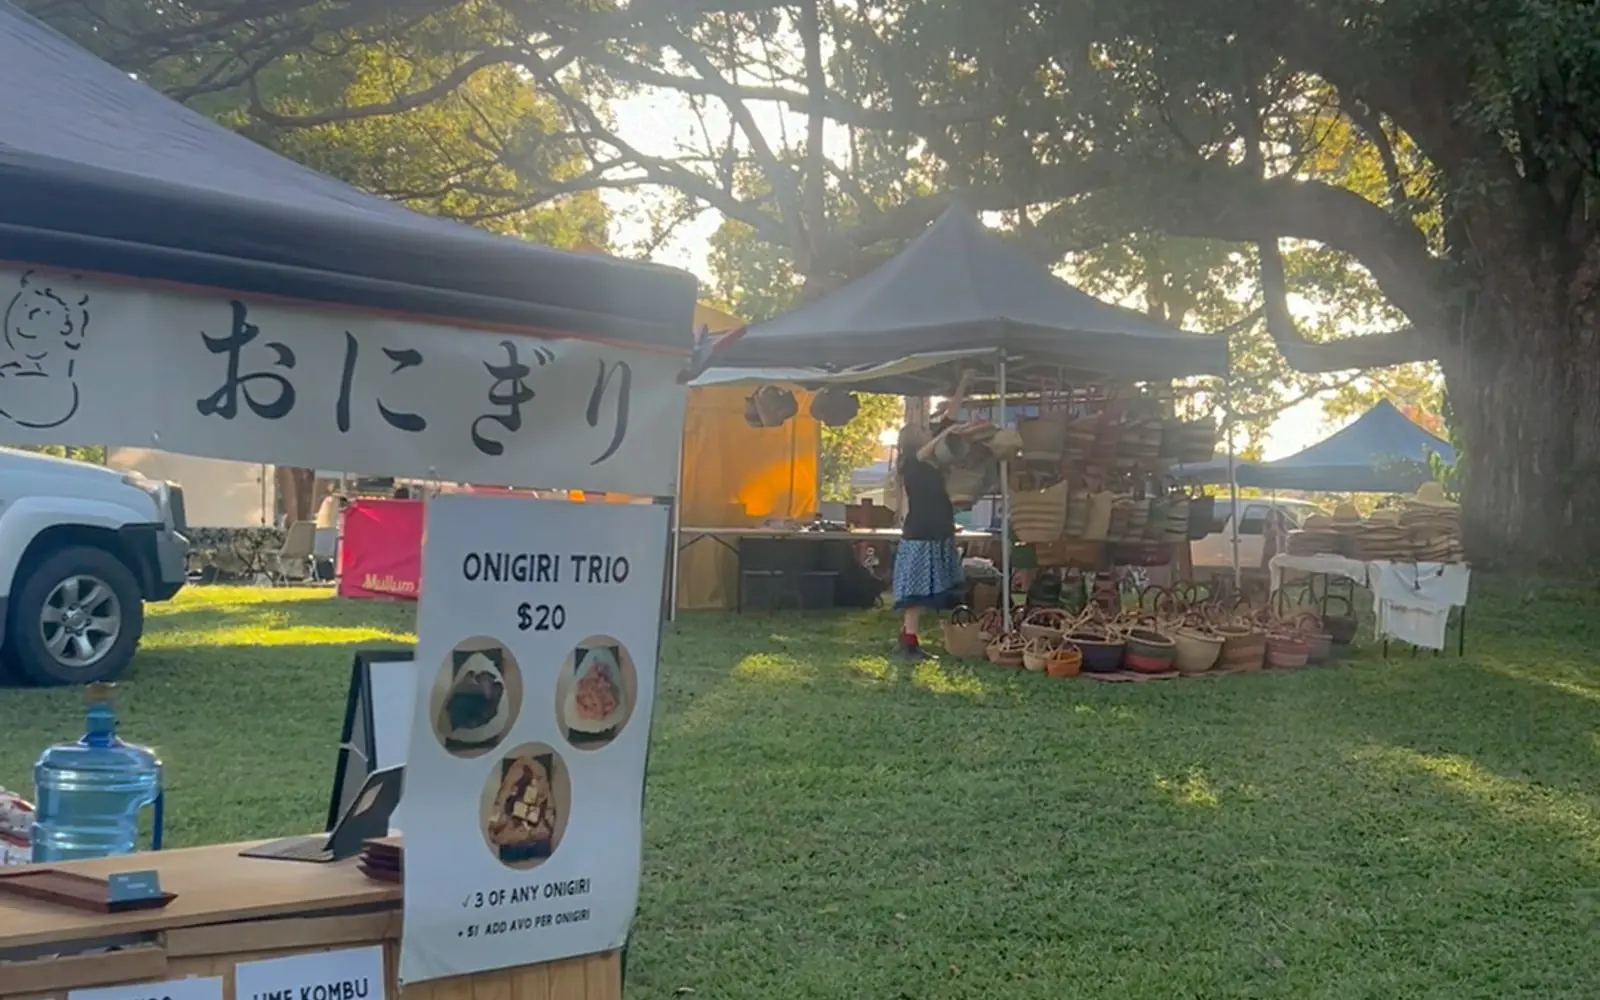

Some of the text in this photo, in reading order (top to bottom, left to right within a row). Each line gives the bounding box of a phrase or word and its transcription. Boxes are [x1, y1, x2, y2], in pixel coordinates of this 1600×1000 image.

[196, 300, 633, 466] おにぎり
[463, 552, 630, 584] ONIGIRI TRIO
[517, 602, 566, 631] $20
[474, 878, 591, 908] 3 OF ANY ONIGIRI
[484, 920, 507, 936] ADD
[509, 917, 533, 932] AVO
[534, 914, 553, 929] PER
[554, 908, 591, 925] ONIGIRI
[300, 977, 369, 1000] KOMBU
